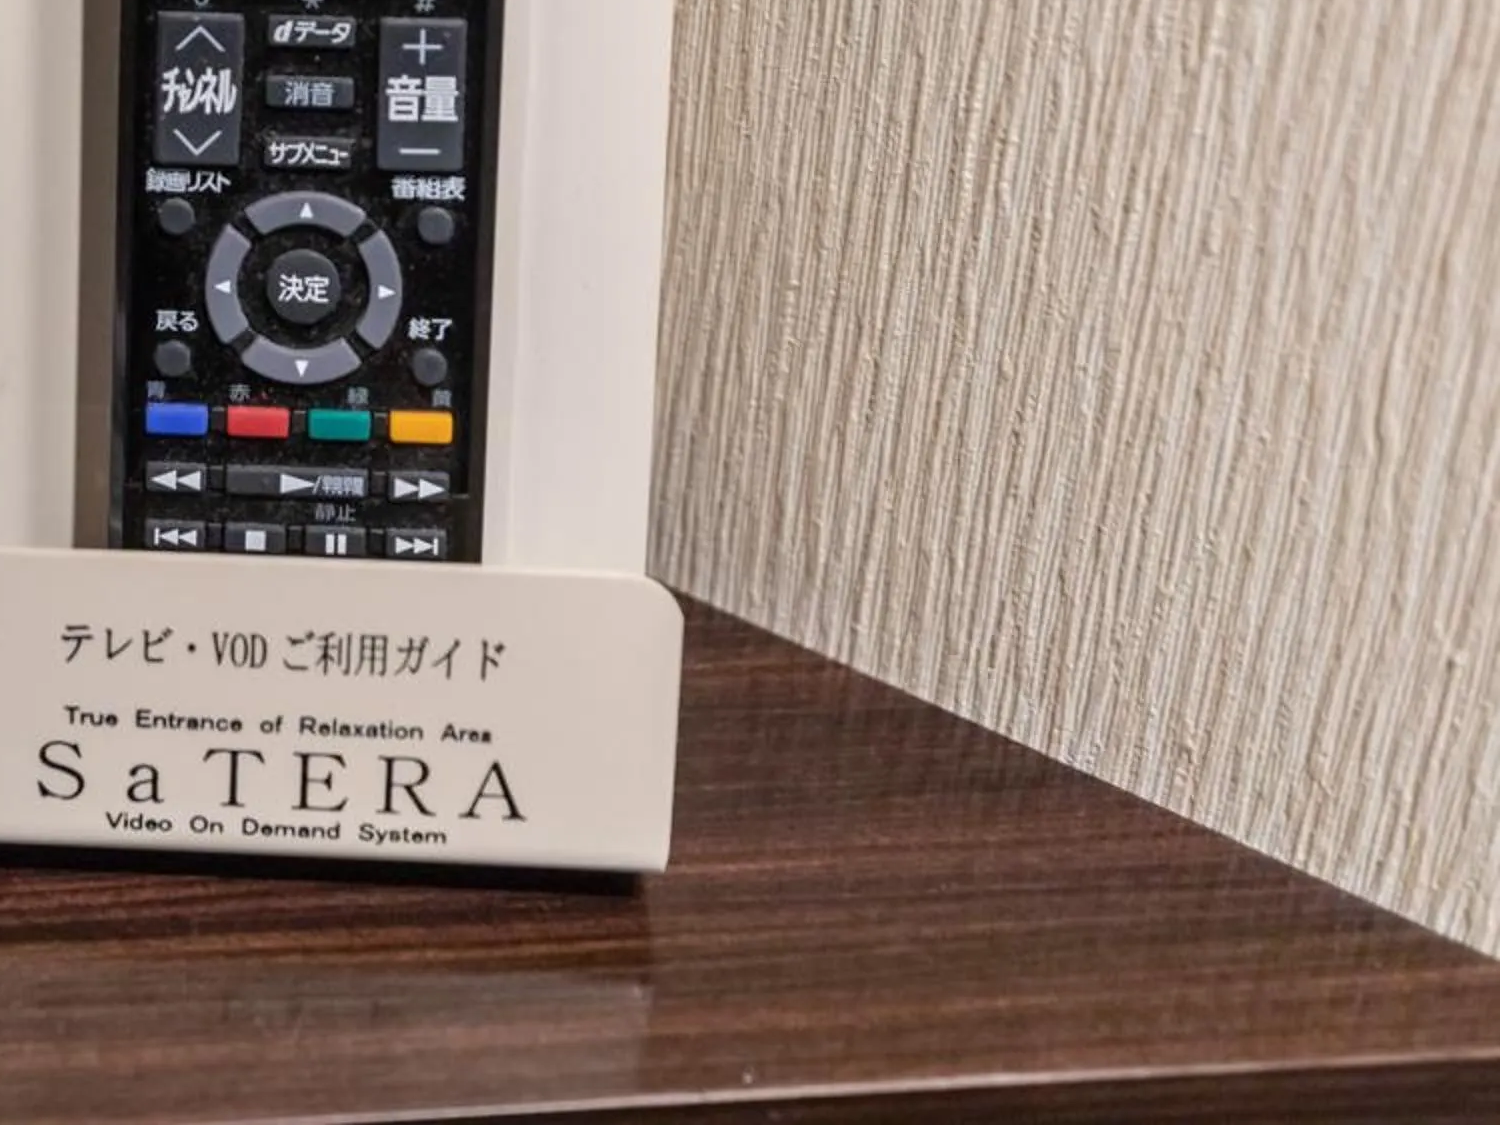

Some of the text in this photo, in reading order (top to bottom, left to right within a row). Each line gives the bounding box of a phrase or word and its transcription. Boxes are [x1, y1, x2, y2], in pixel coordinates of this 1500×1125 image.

[272, 19, 353, 44] dデータ
[284, 80, 336, 107] 消音
[385, 74, 460, 123] 音量
[268, 141, 350, 167] サブメニュー
[390, 175, 467, 202] 番組表
[278, 274, 331, 305] 決定
[155, 308, 199, 333] 戻る
[407, 316, 453, 342] 終了
[229, 383, 251, 403] 赤
[63, 704, 493, 745] True Entrance of Relaxation Area
[34, 739, 528, 823] SaTERA
[105, 811, 449, 847] Video On Demand System
